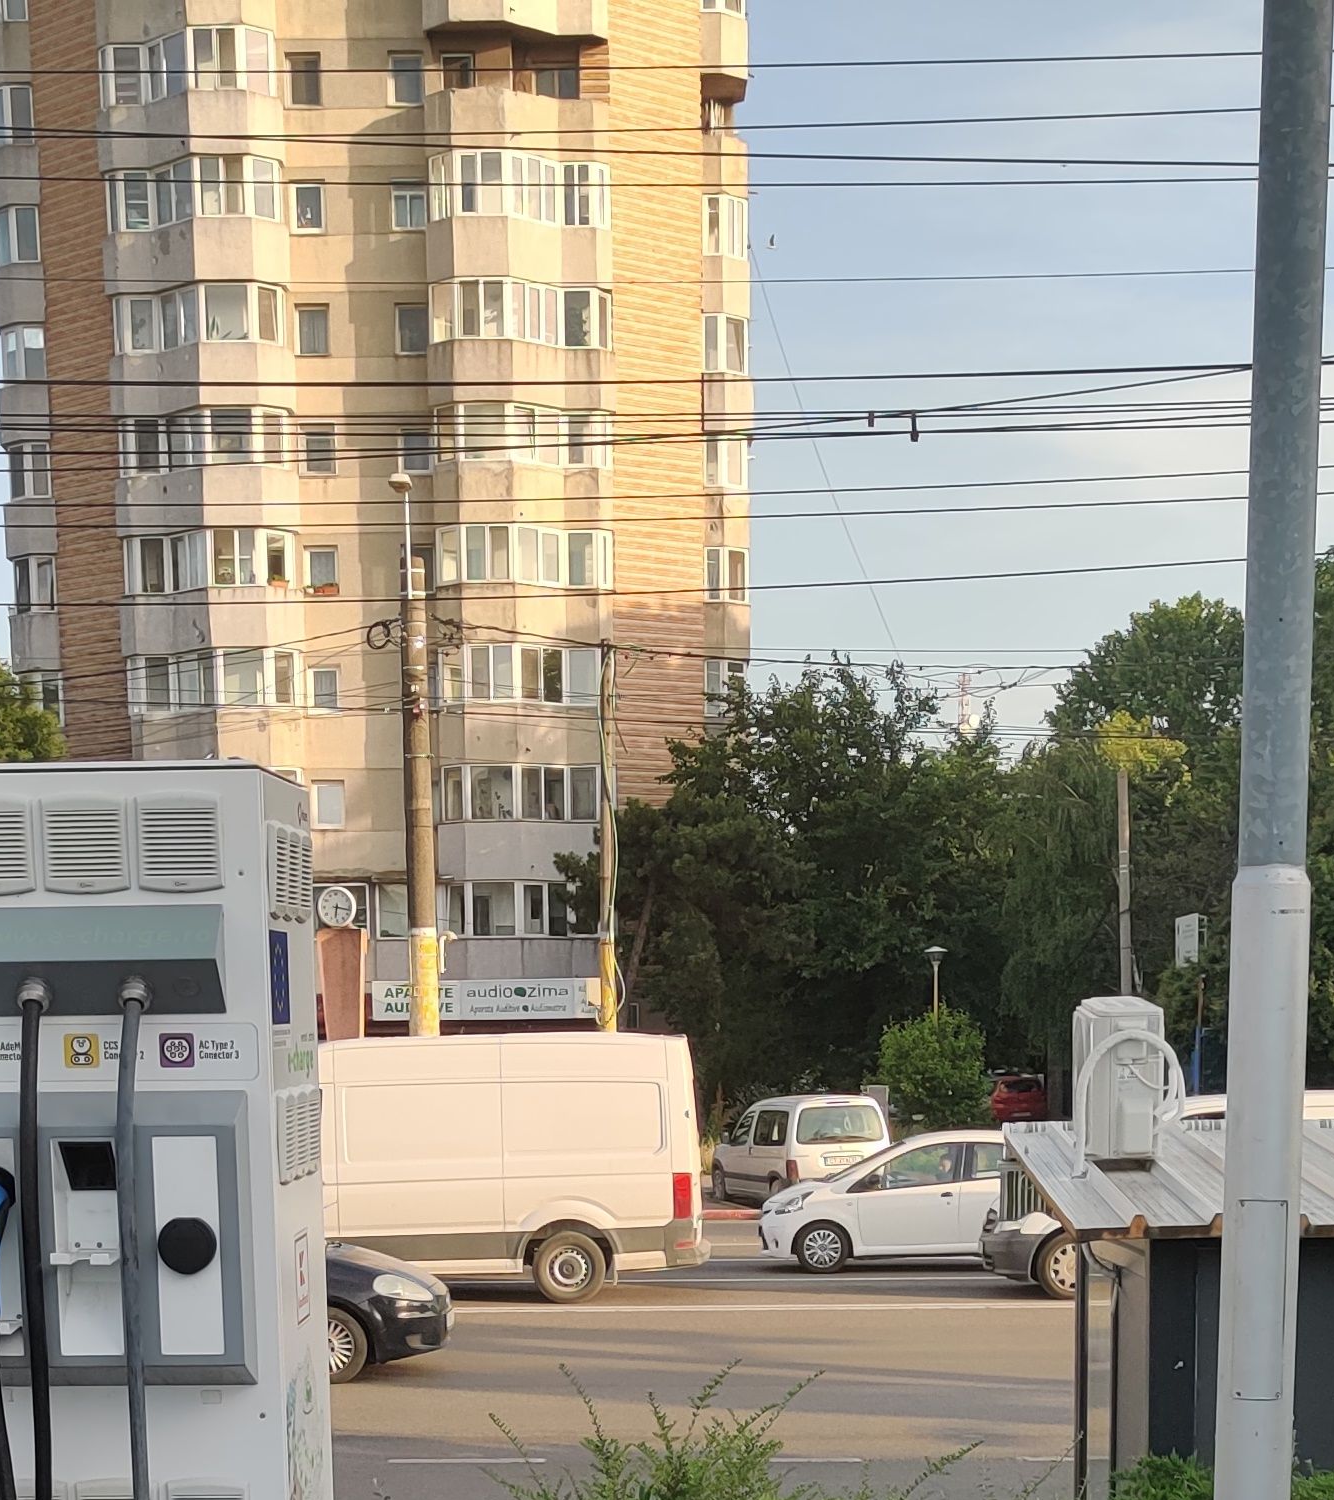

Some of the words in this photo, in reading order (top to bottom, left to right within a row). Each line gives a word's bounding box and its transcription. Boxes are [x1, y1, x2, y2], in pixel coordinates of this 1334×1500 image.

[384, 986, 454, 999] APATE
[103, 1041, 119, 1050] CCS
[198, 1040, 210, 1050] AC
[210, 1040, 229, 1051] Type
[229, 1040, 235, 1049] 2
[139, 1051, 145, 1060] 2
[198, 1050, 233, 1060] Conector
[234, 1050, 240, 1060] 3
